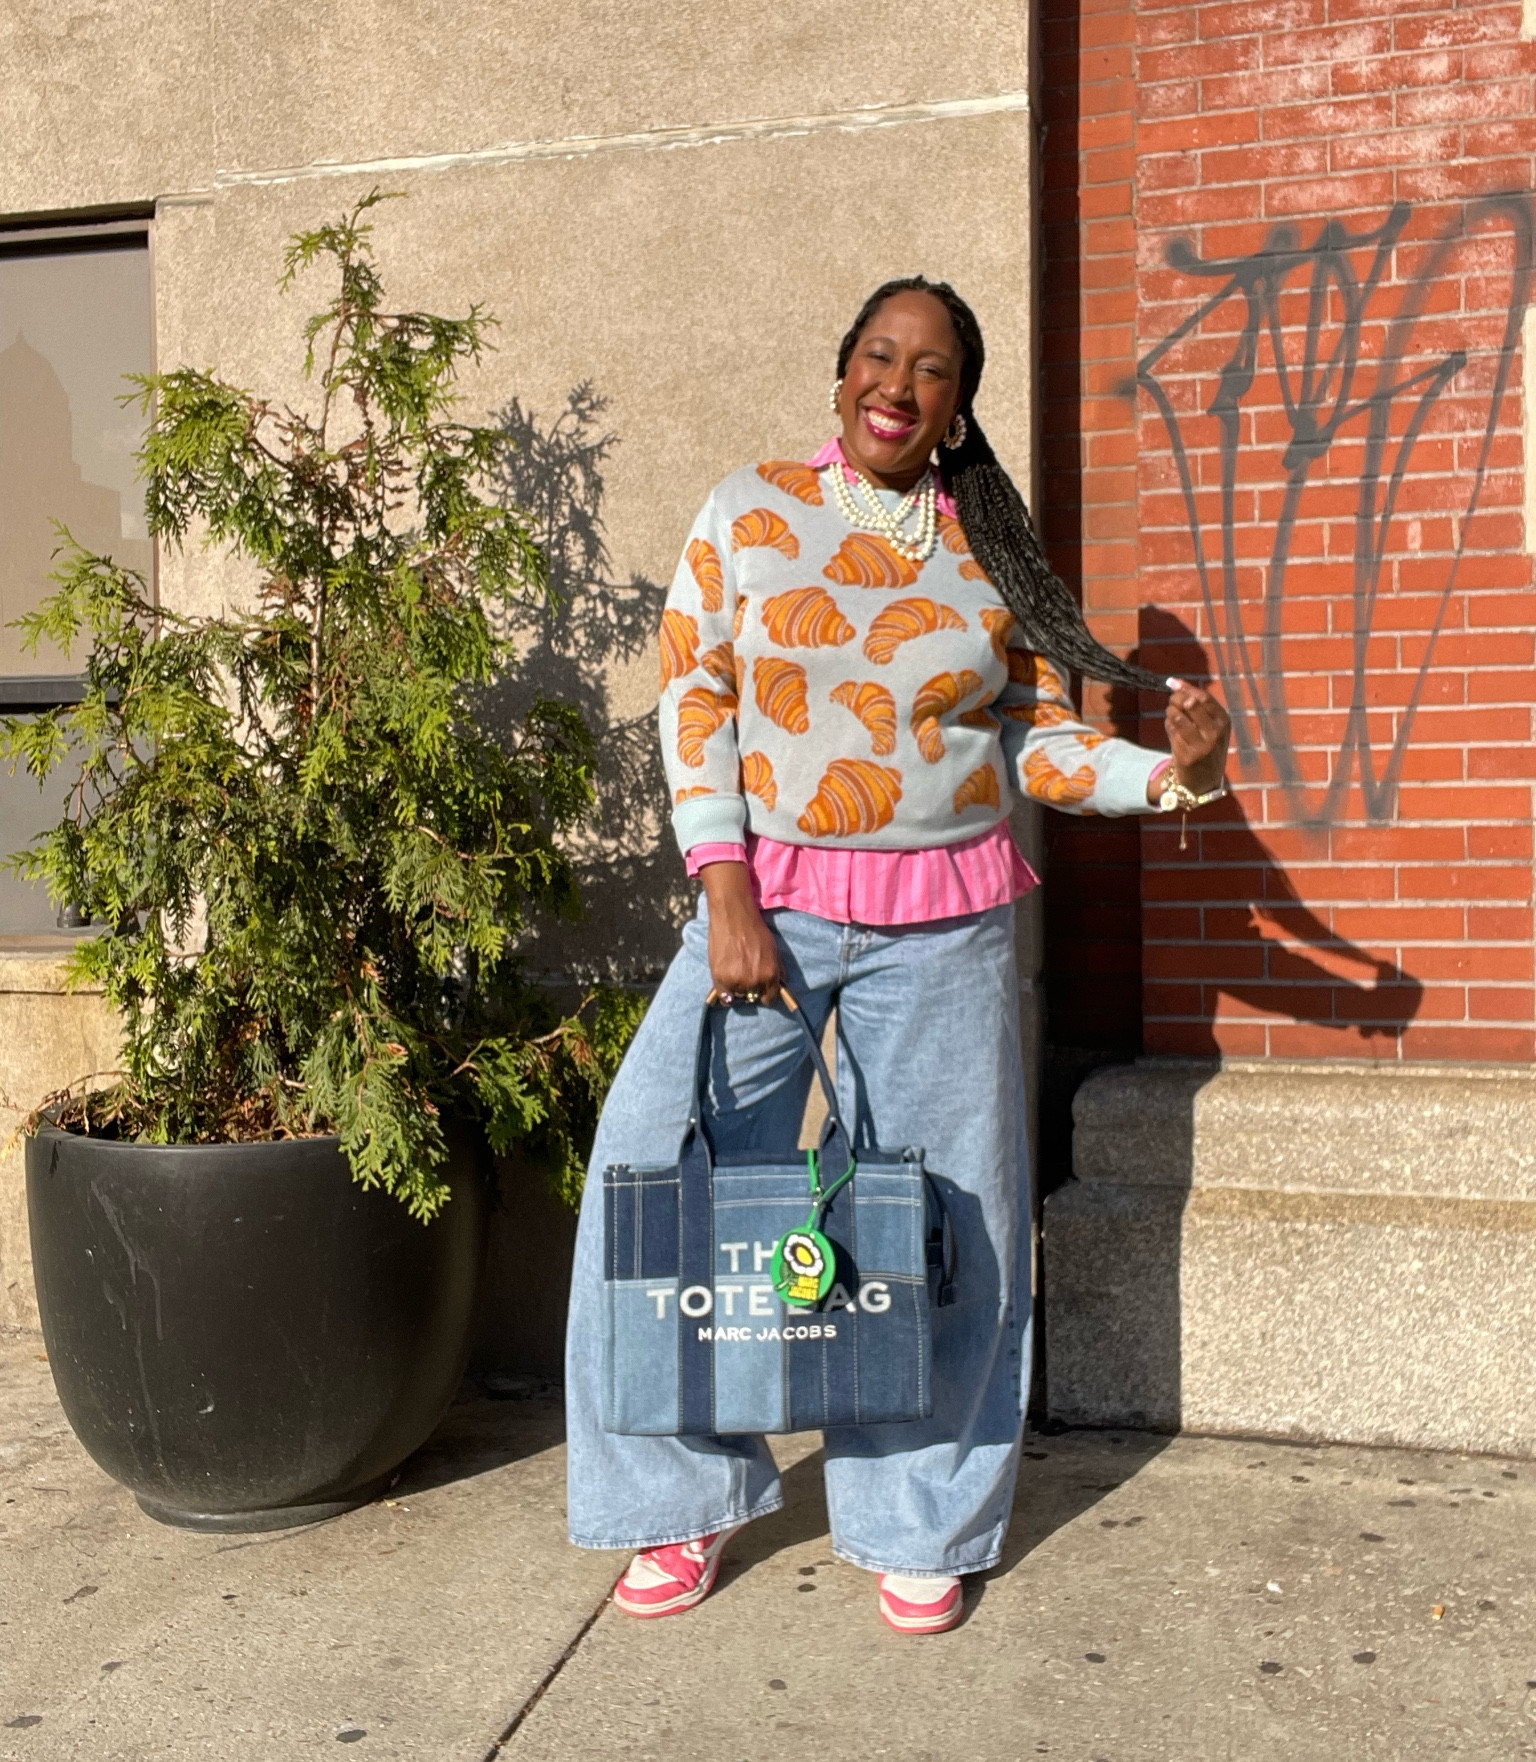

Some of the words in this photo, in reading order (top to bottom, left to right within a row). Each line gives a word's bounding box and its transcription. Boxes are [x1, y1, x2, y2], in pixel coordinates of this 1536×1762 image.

[721, 1241, 778, 1272] TH
[647, 1285, 775, 1319] TOTE
[787, 1281, 892, 1314] AG
[698, 1326, 752, 1341] MARC
[756, 1324, 837, 1341] JACOBS
